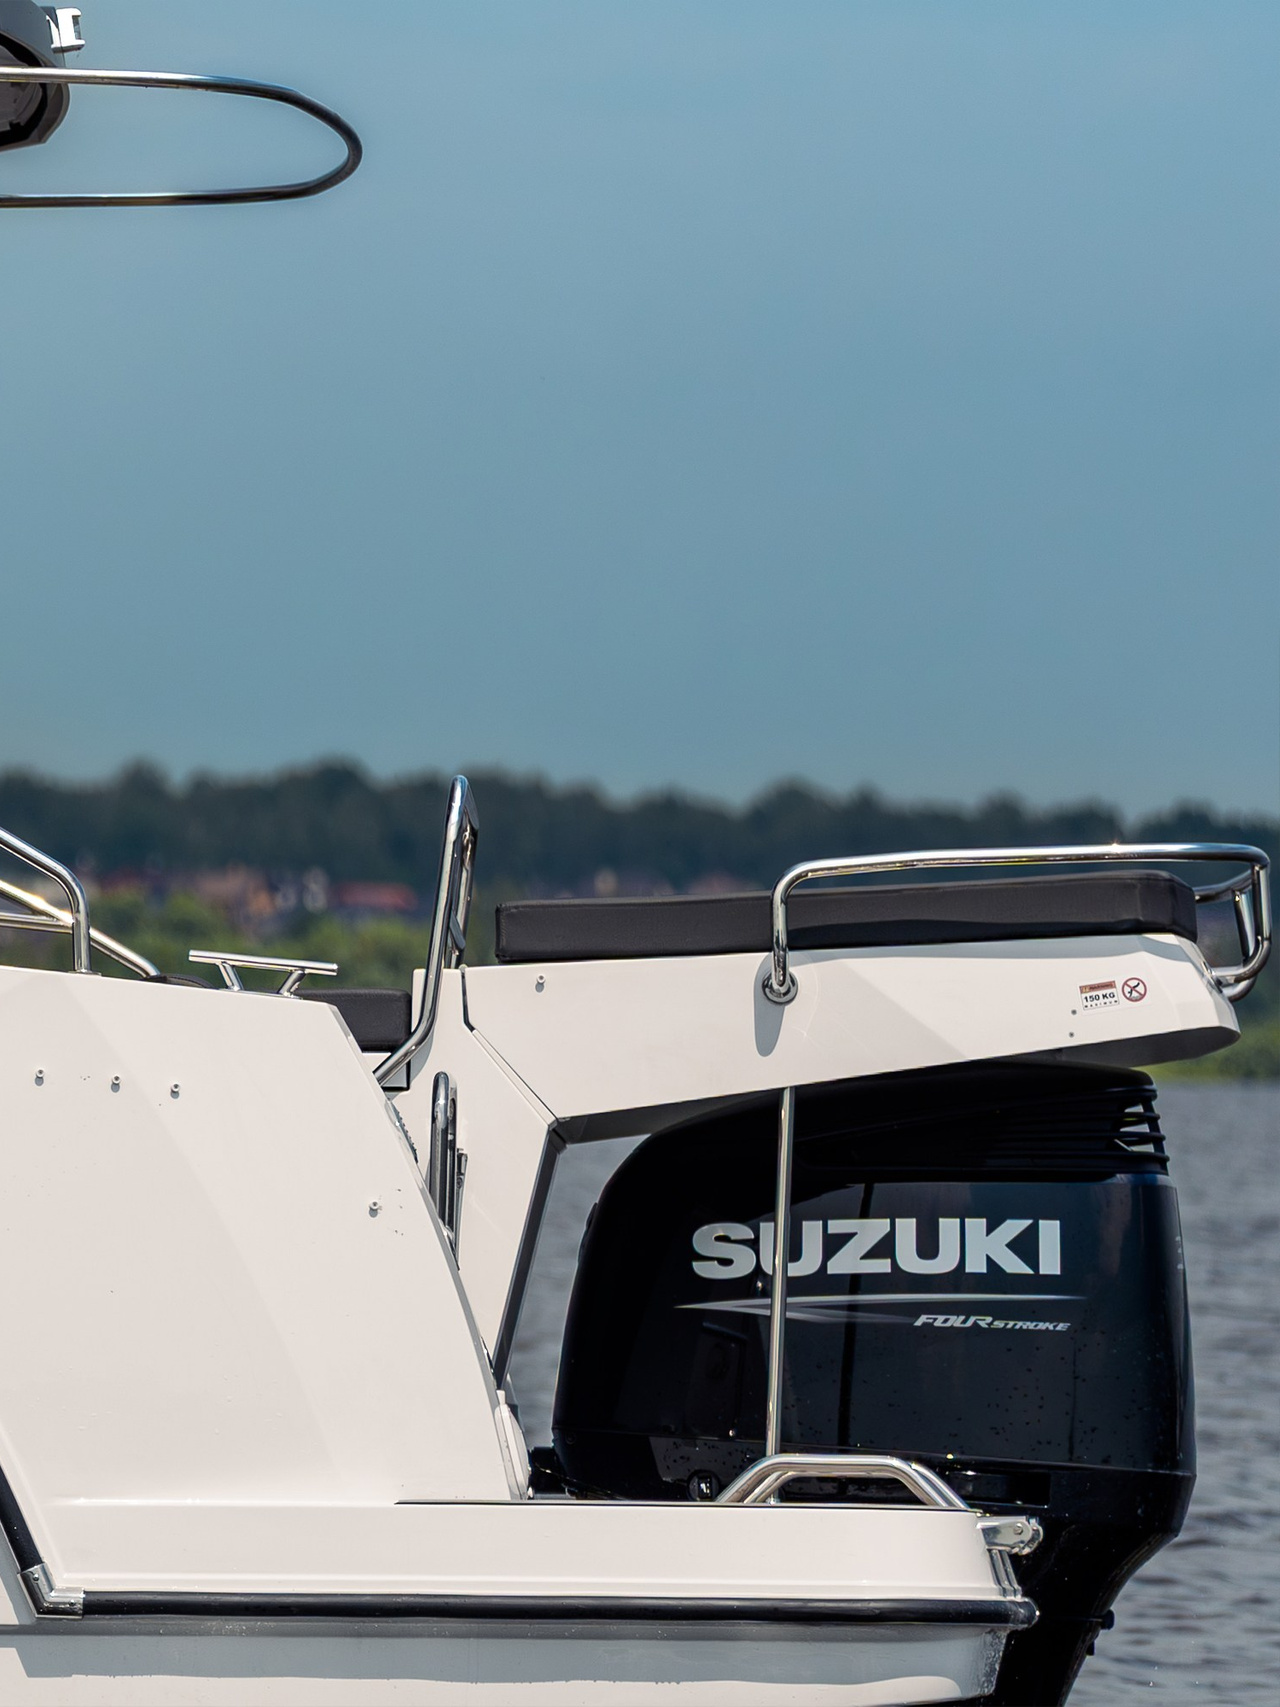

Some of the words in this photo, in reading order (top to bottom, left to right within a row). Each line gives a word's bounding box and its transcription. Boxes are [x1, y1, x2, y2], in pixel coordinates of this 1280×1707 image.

[1084, 994, 1100, 1003] 150
[1102, 992, 1116, 1000] KG
[692, 1217, 1061, 1280] SUZUKI
